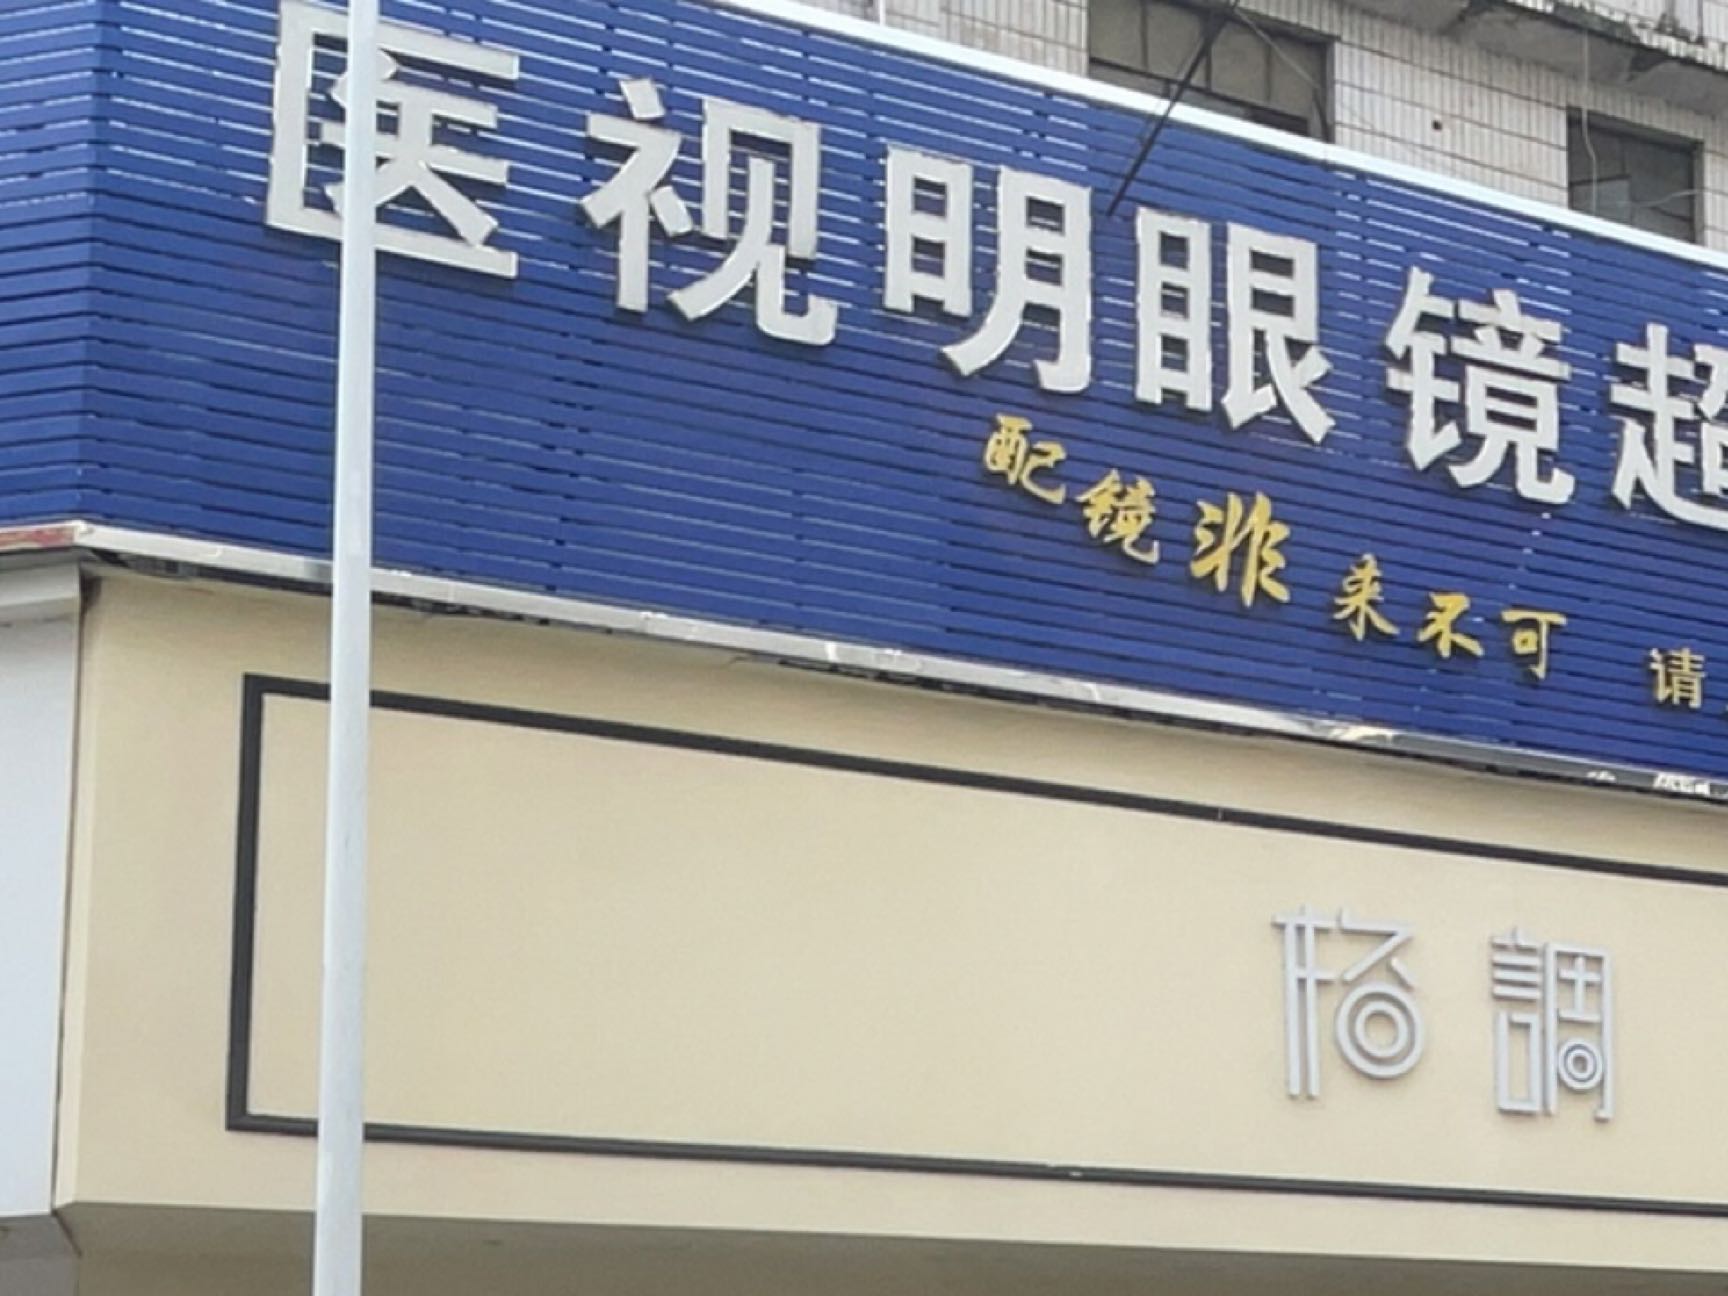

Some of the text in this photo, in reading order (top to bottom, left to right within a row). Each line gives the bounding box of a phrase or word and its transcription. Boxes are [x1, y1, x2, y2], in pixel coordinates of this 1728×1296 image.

[980, 413, 1569, 681] 配镜非来不可
